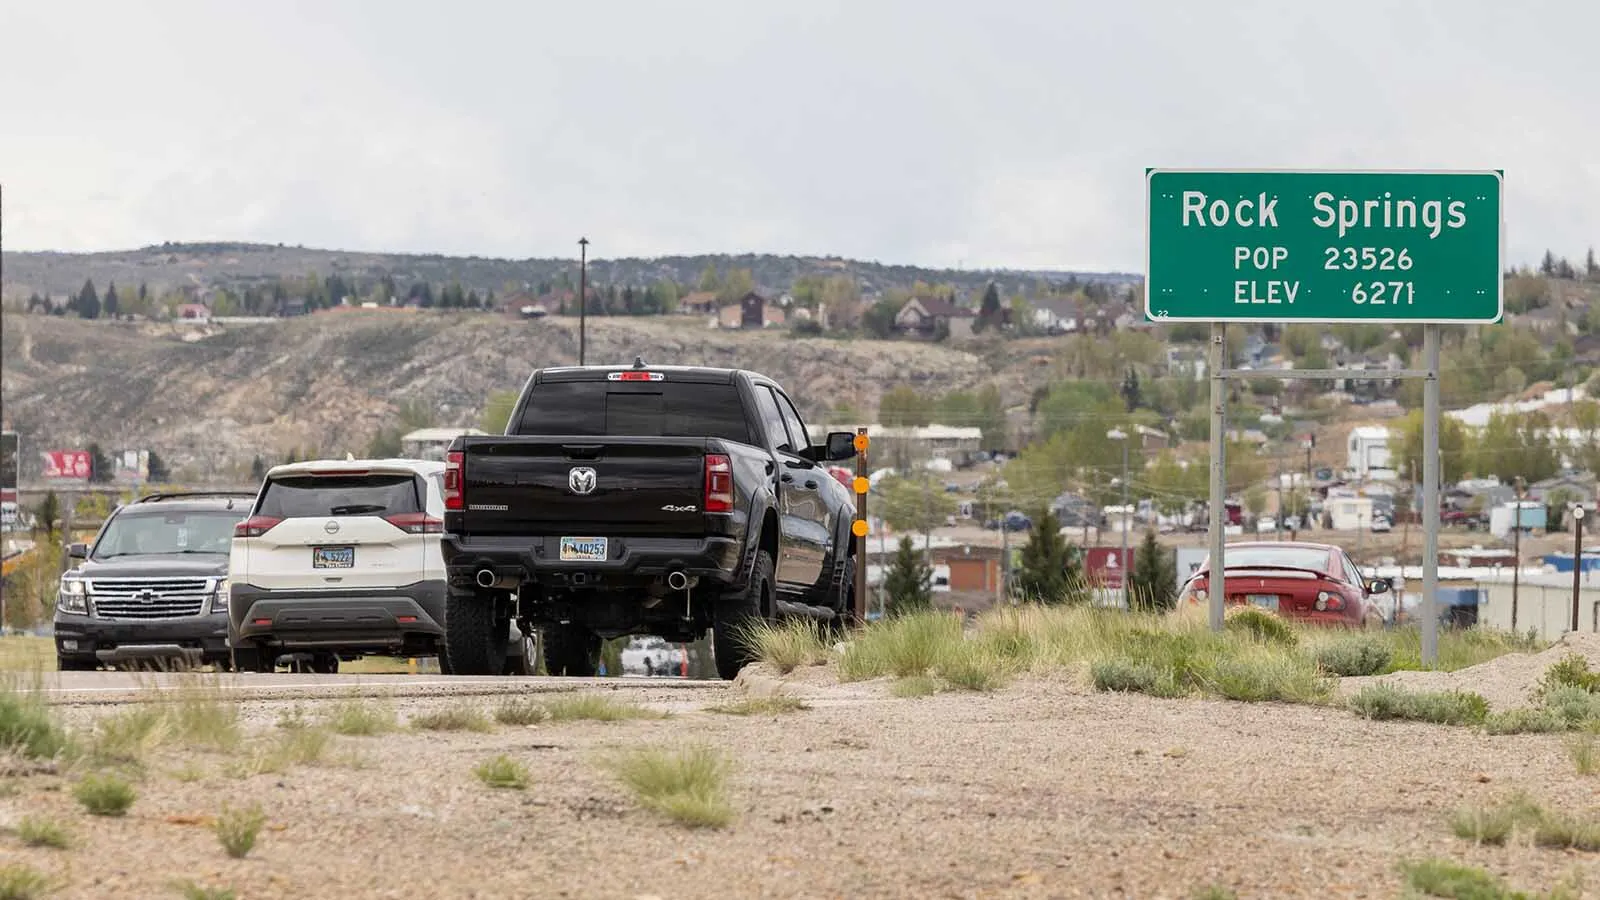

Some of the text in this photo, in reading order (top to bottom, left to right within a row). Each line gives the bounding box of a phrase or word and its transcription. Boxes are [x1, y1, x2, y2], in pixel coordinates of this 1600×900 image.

[1182, 190, 1467, 239] Rock Springs
[1234, 246, 1413, 270] POP 23526
[1234, 280, 1414, 305] ELEV 6271
[1157, 309, 1169, 318] 22
